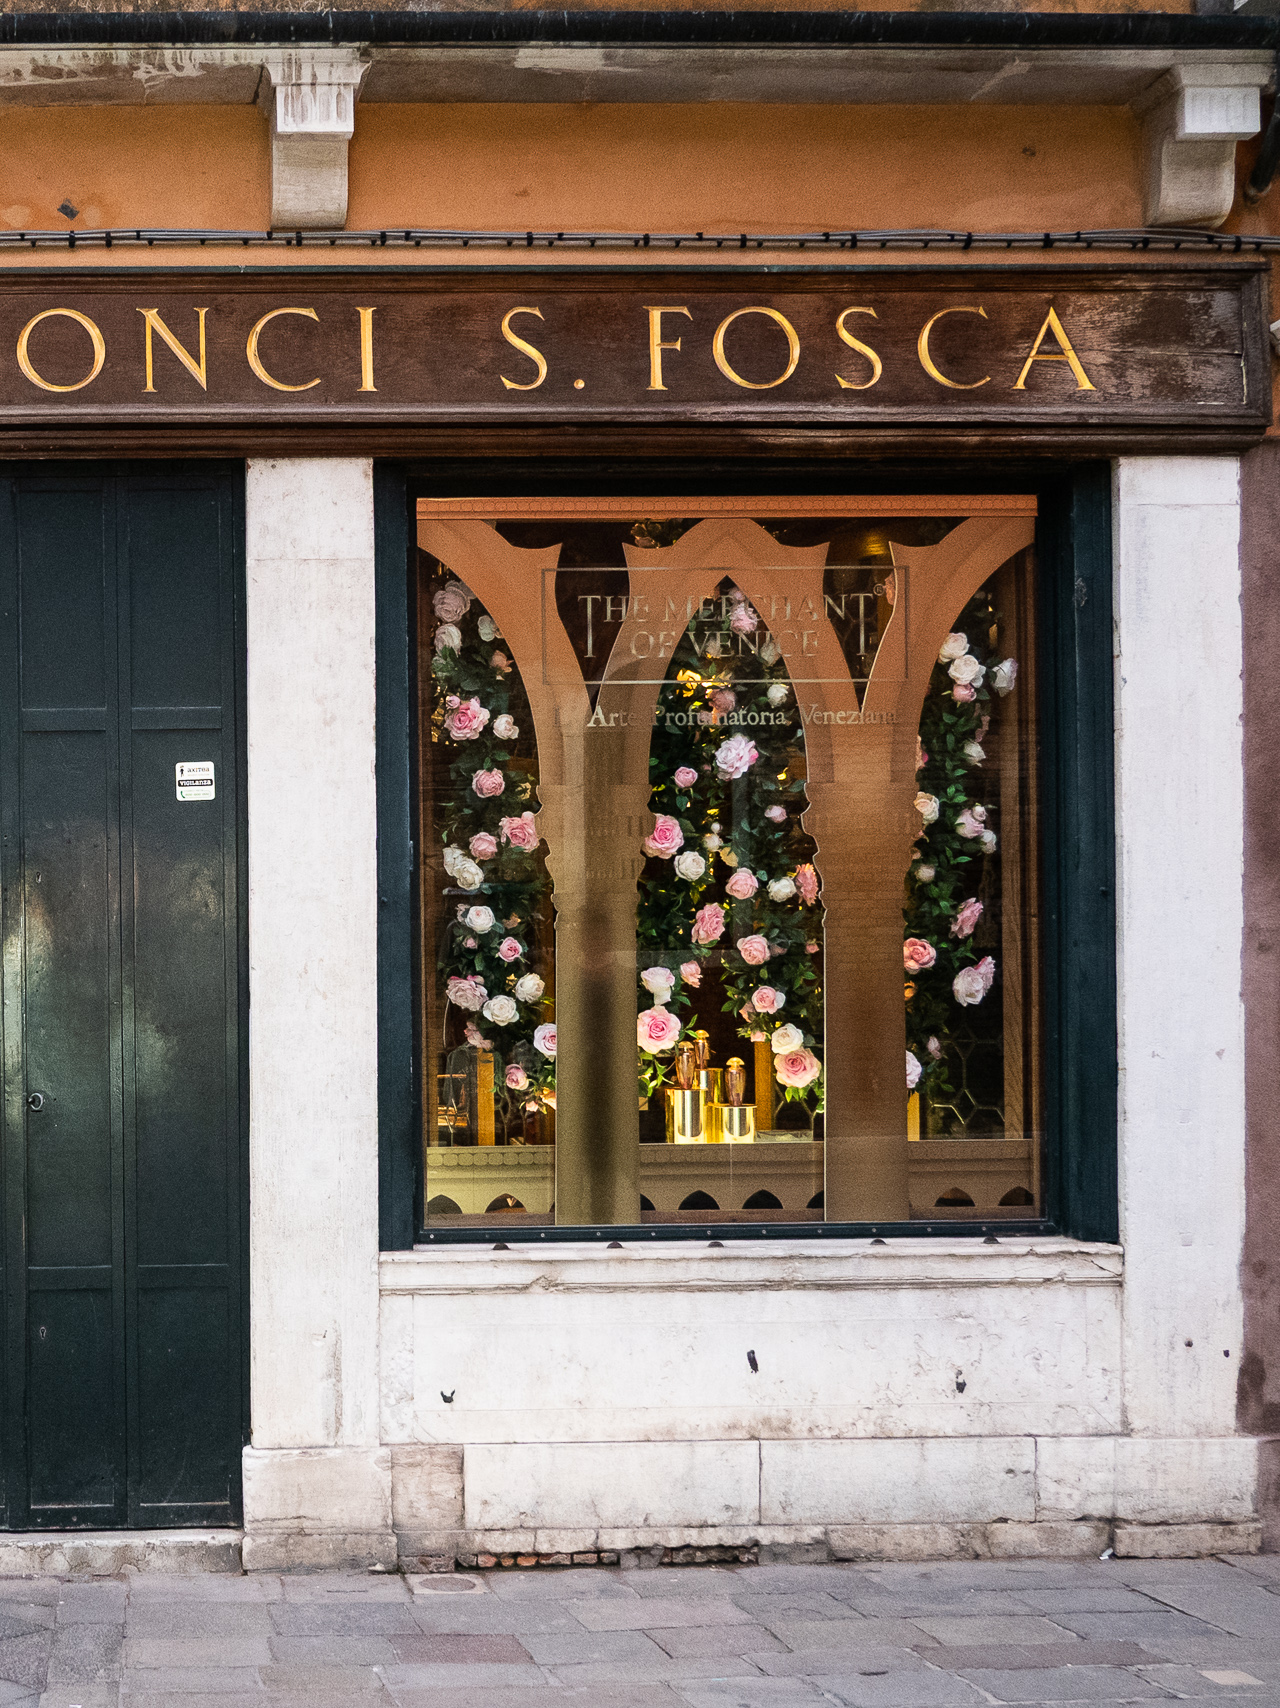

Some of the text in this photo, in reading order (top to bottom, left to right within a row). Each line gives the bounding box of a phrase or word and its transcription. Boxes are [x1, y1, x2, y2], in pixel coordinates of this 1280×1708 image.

[500, 307, 585, 392] S.
[643, 305, 1097, 392] FOSCA
[577, 595, 650, 657] THE
[630, 629, 819, 659] OF VENICE
